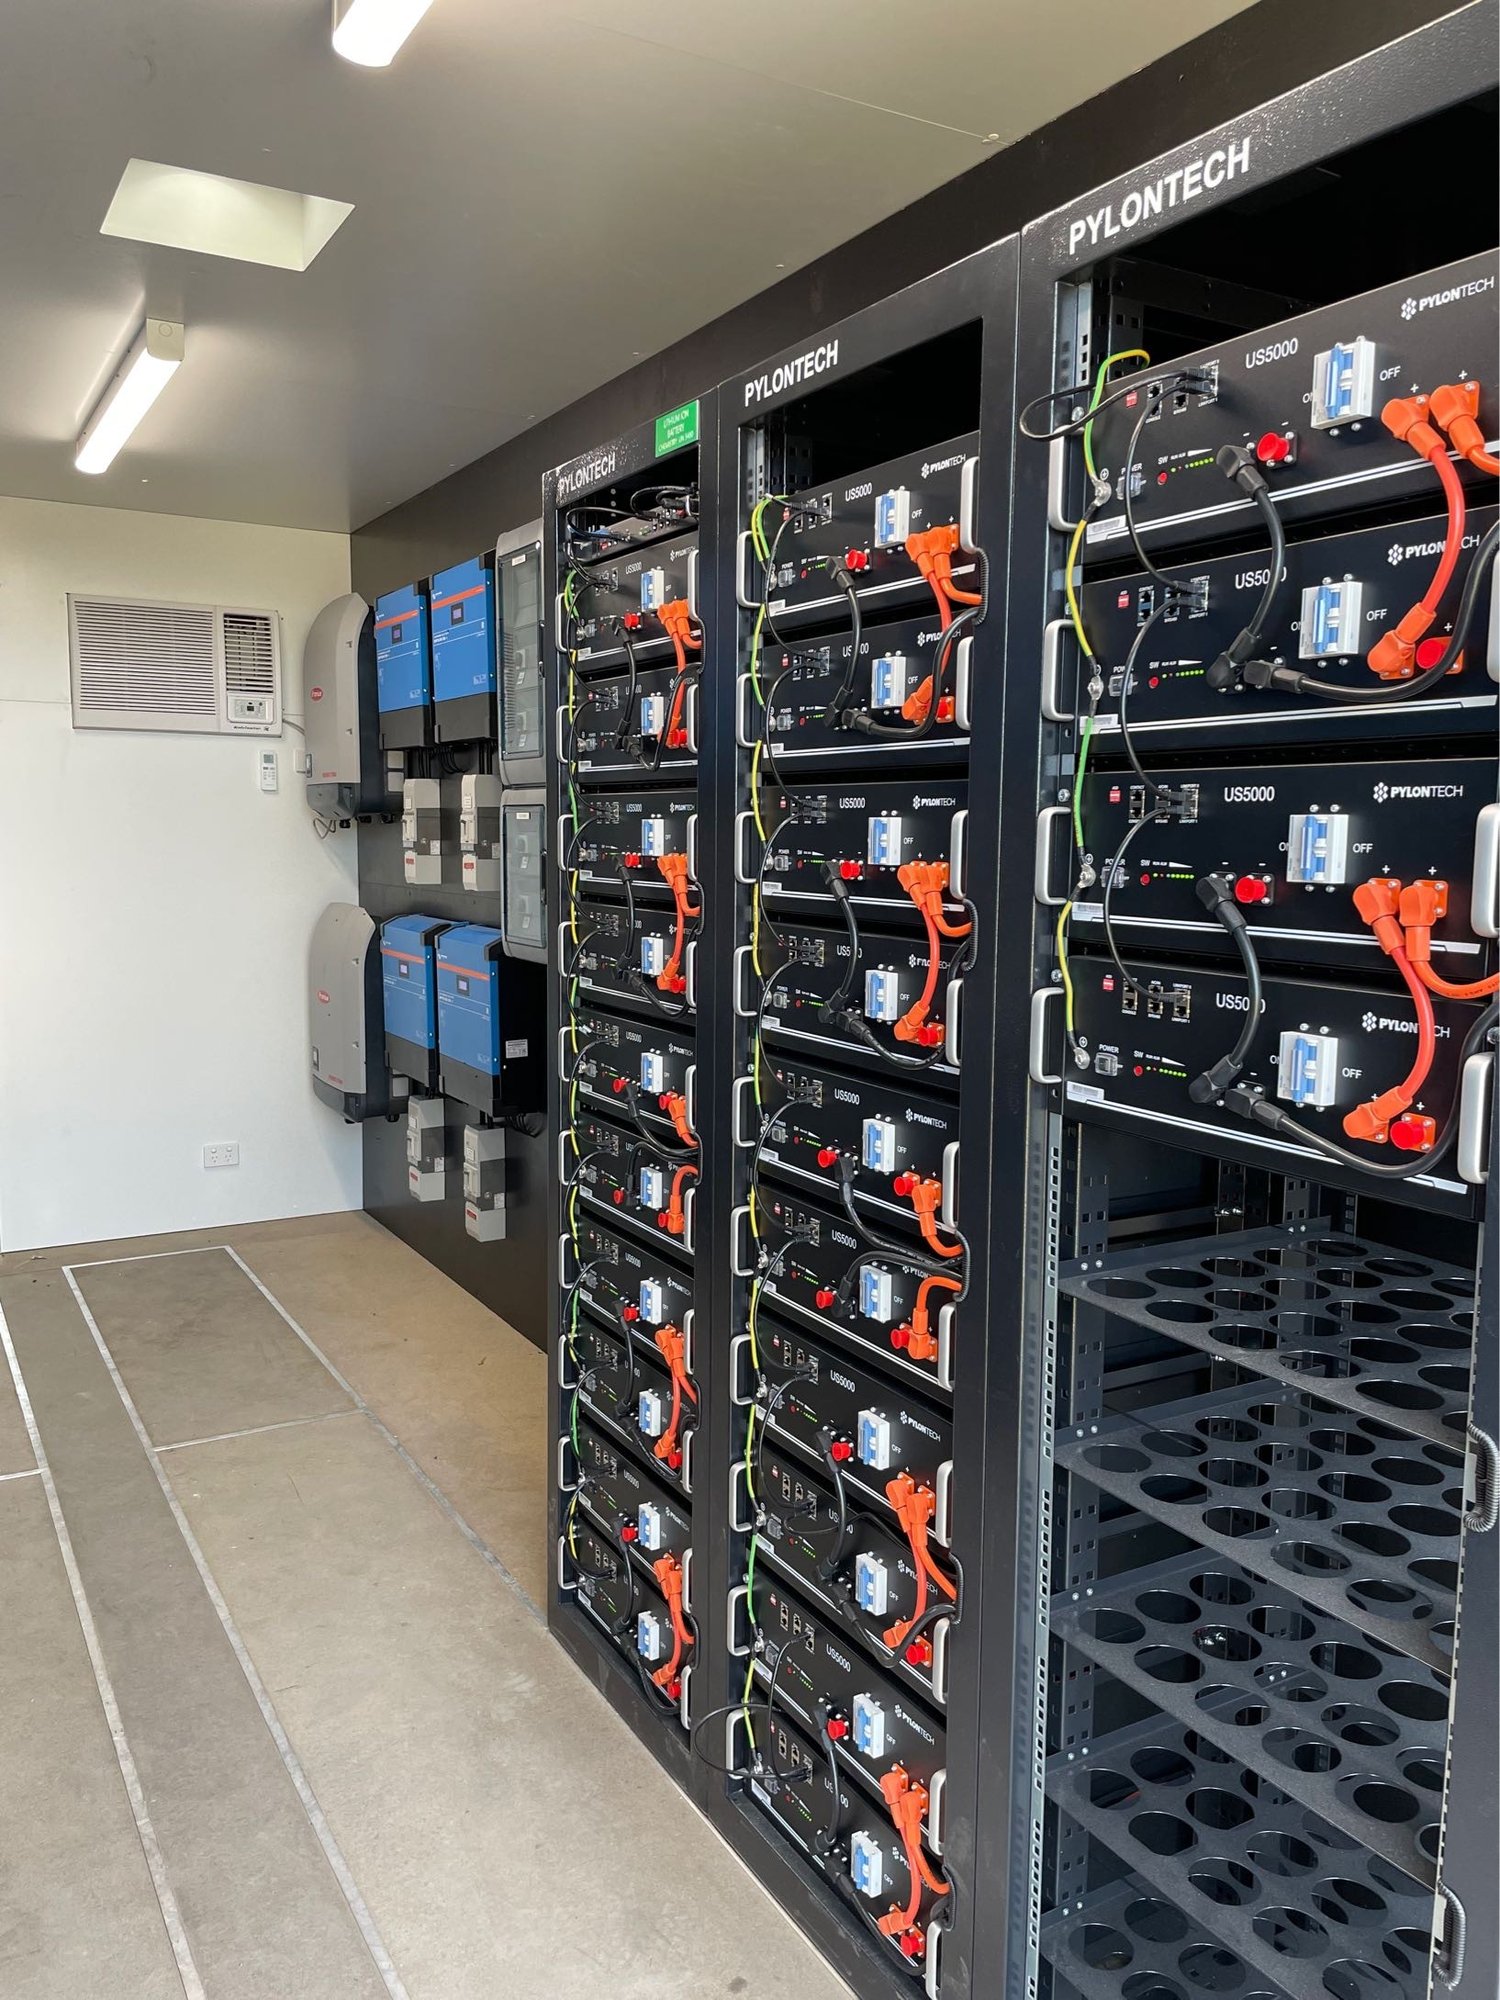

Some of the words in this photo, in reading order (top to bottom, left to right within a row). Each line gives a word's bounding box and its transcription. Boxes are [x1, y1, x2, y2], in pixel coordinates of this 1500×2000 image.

[1069, 136, 1251, 255] PYLONTECH
[1419, 276, 1495, 311] PYLONTECH
[1245, 338, 1299, 369] US5000
[744, 339, 839, 407] PYLONTECH
[1379, 366, 1401, 381] OFF
[930, 454, 967, 473] PYLONTECH
[557, 451, 616, 498] PYLONTECH
[845, 483, 872, 502] US5000
[1405, 535, 1480, 558] PYLONCH
[1366, 609, 1388, 622] OFF
[842, 642, 870, 657] US00
[1224, 786, 1275, 802] US5000
[1390, 785, 1464, 798] PYLONTECH
[839, 797, 866, 809] US5000
[921, 797, 956, 807] PYLONTECH
[1352, 843, 1373, 853] OFF
[836, 945, 863, 958] US50
[1379, 1018, 1451, 1038] PYLONCH
[1342, 1067, 1362, 1079] OFF
[834, 1088, 860, 1105] US5000
[913, 1113, 947, 1130] PYLONTECH
[831, 1230, 857, 1249] US5000
[830, 1369, 856, 1392] US5000
[908, 1417, 941, 1442] PYLONTECH
[826, 1643, 851, 1672] US5000
[902, 1712, 935, 1746] PYLONTECH
